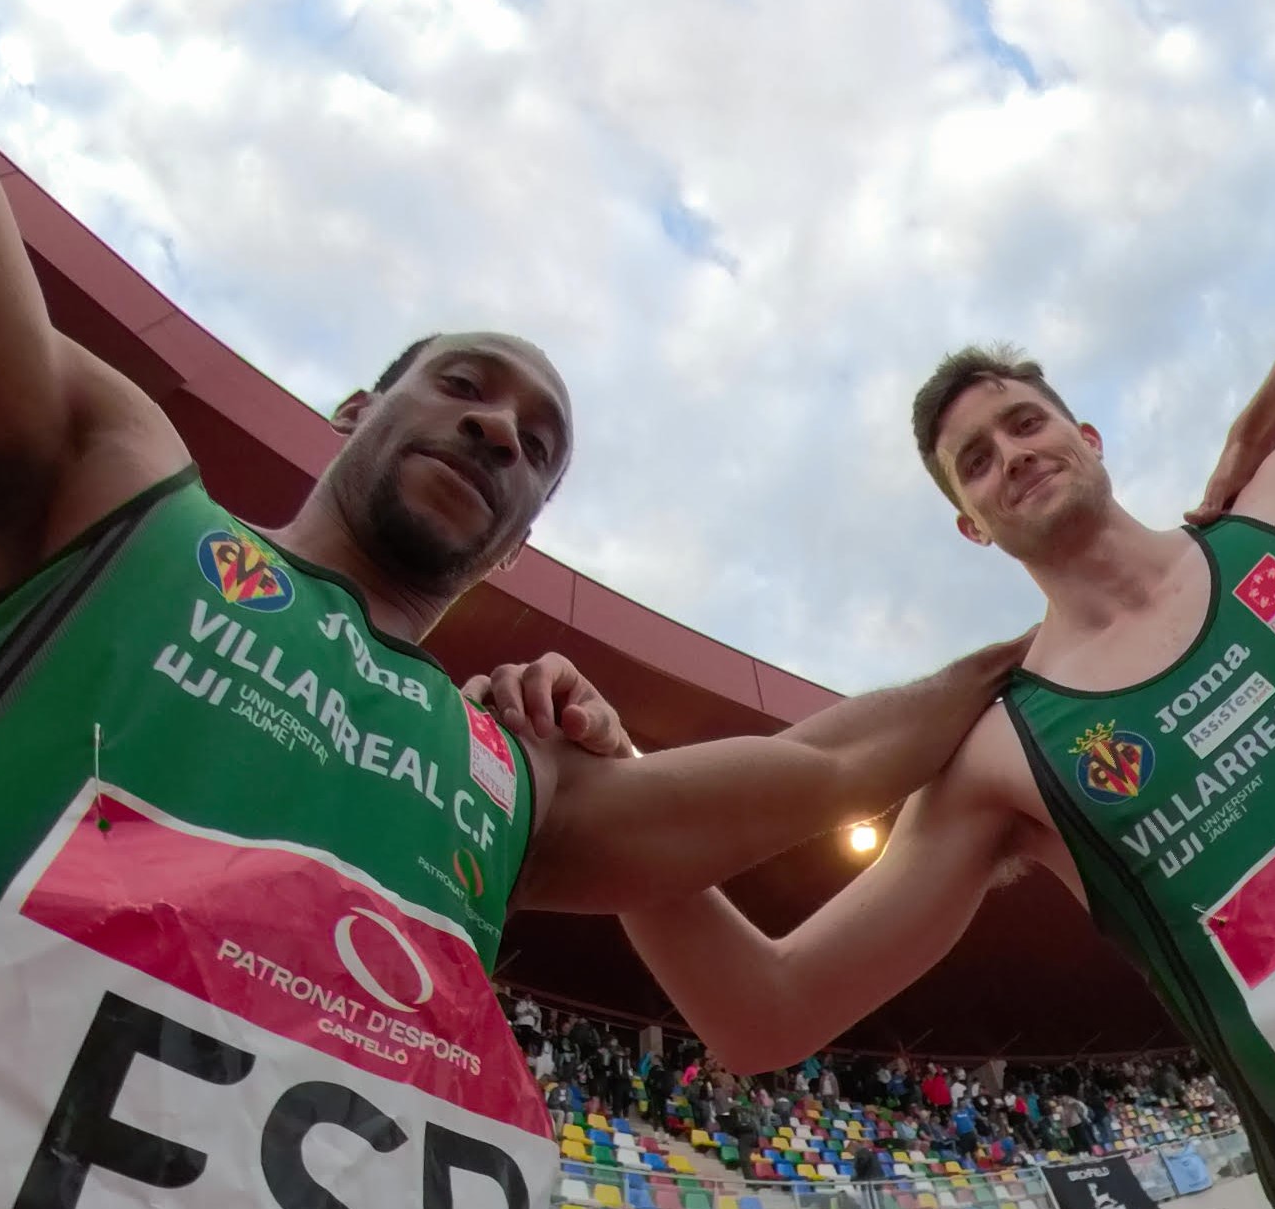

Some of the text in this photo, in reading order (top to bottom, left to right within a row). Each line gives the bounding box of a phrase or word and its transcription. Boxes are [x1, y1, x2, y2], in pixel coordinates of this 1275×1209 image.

[190, 599, 445, 810] VILLARREAL
[230, 701, 290, 744] JAUME
[1199, 774, 1265, 834] UNIVERSITAT
[1208, 810, 1243, 843] JAUME
[417, 855, 466, 900] PATRONAT
[216, 939, 482, 1077] PATRONAT D'ESPORTS
